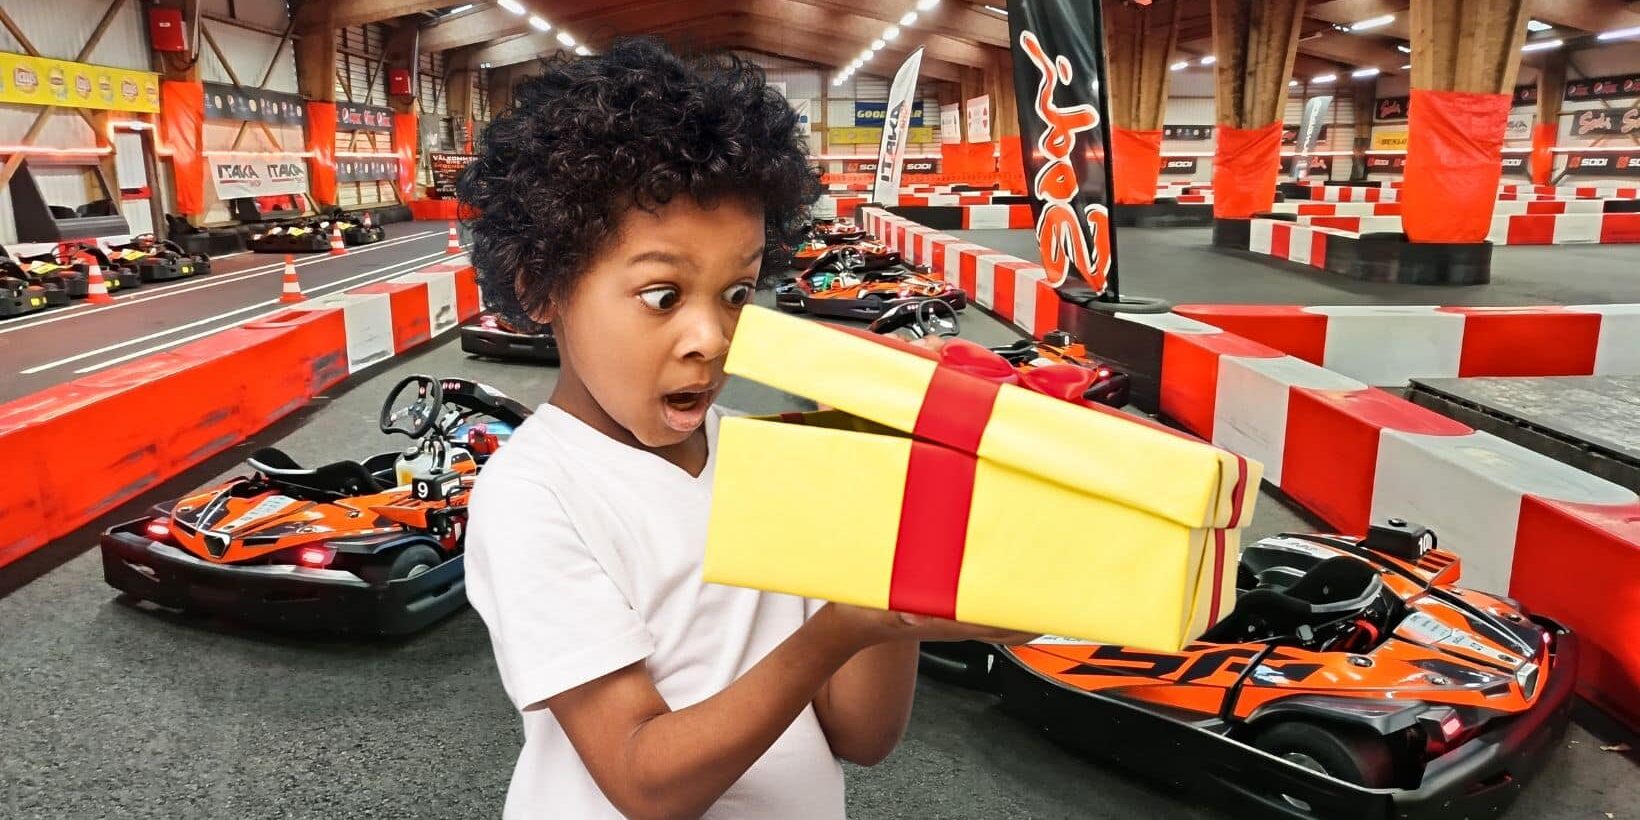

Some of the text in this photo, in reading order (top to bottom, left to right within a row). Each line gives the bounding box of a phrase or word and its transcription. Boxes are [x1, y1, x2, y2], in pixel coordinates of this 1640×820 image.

[881, 100, 905, 182] ITAKA
[218, 164, 260, 179] ITAKA
[1581, 158, 1608, 167] SODI
[417, 481, 429, 499] 9
[1418, 532, 1433, 556] 10
